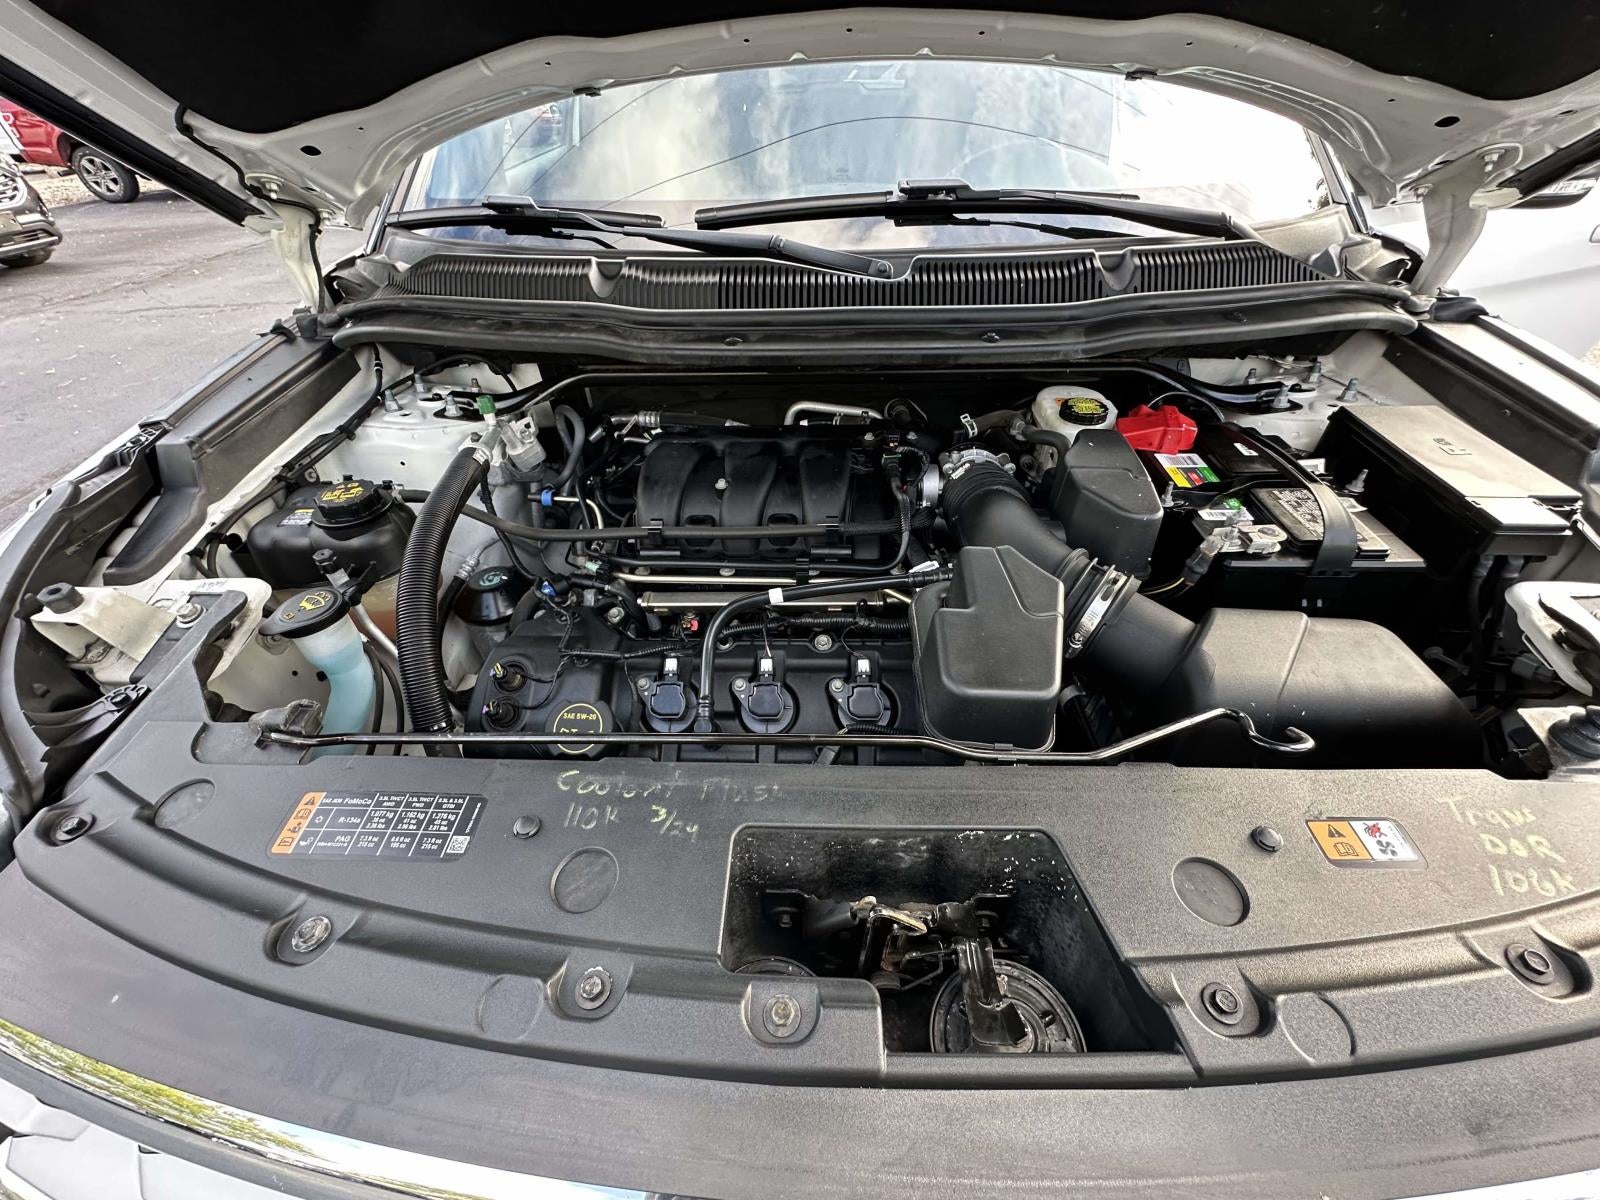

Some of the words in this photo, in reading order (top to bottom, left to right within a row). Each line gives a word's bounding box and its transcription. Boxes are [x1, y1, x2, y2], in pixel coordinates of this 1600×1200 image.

[385, 811, 394, 819] kg
[416, 812, 426, 820] kg
[447, 813, 456, 821] kg
